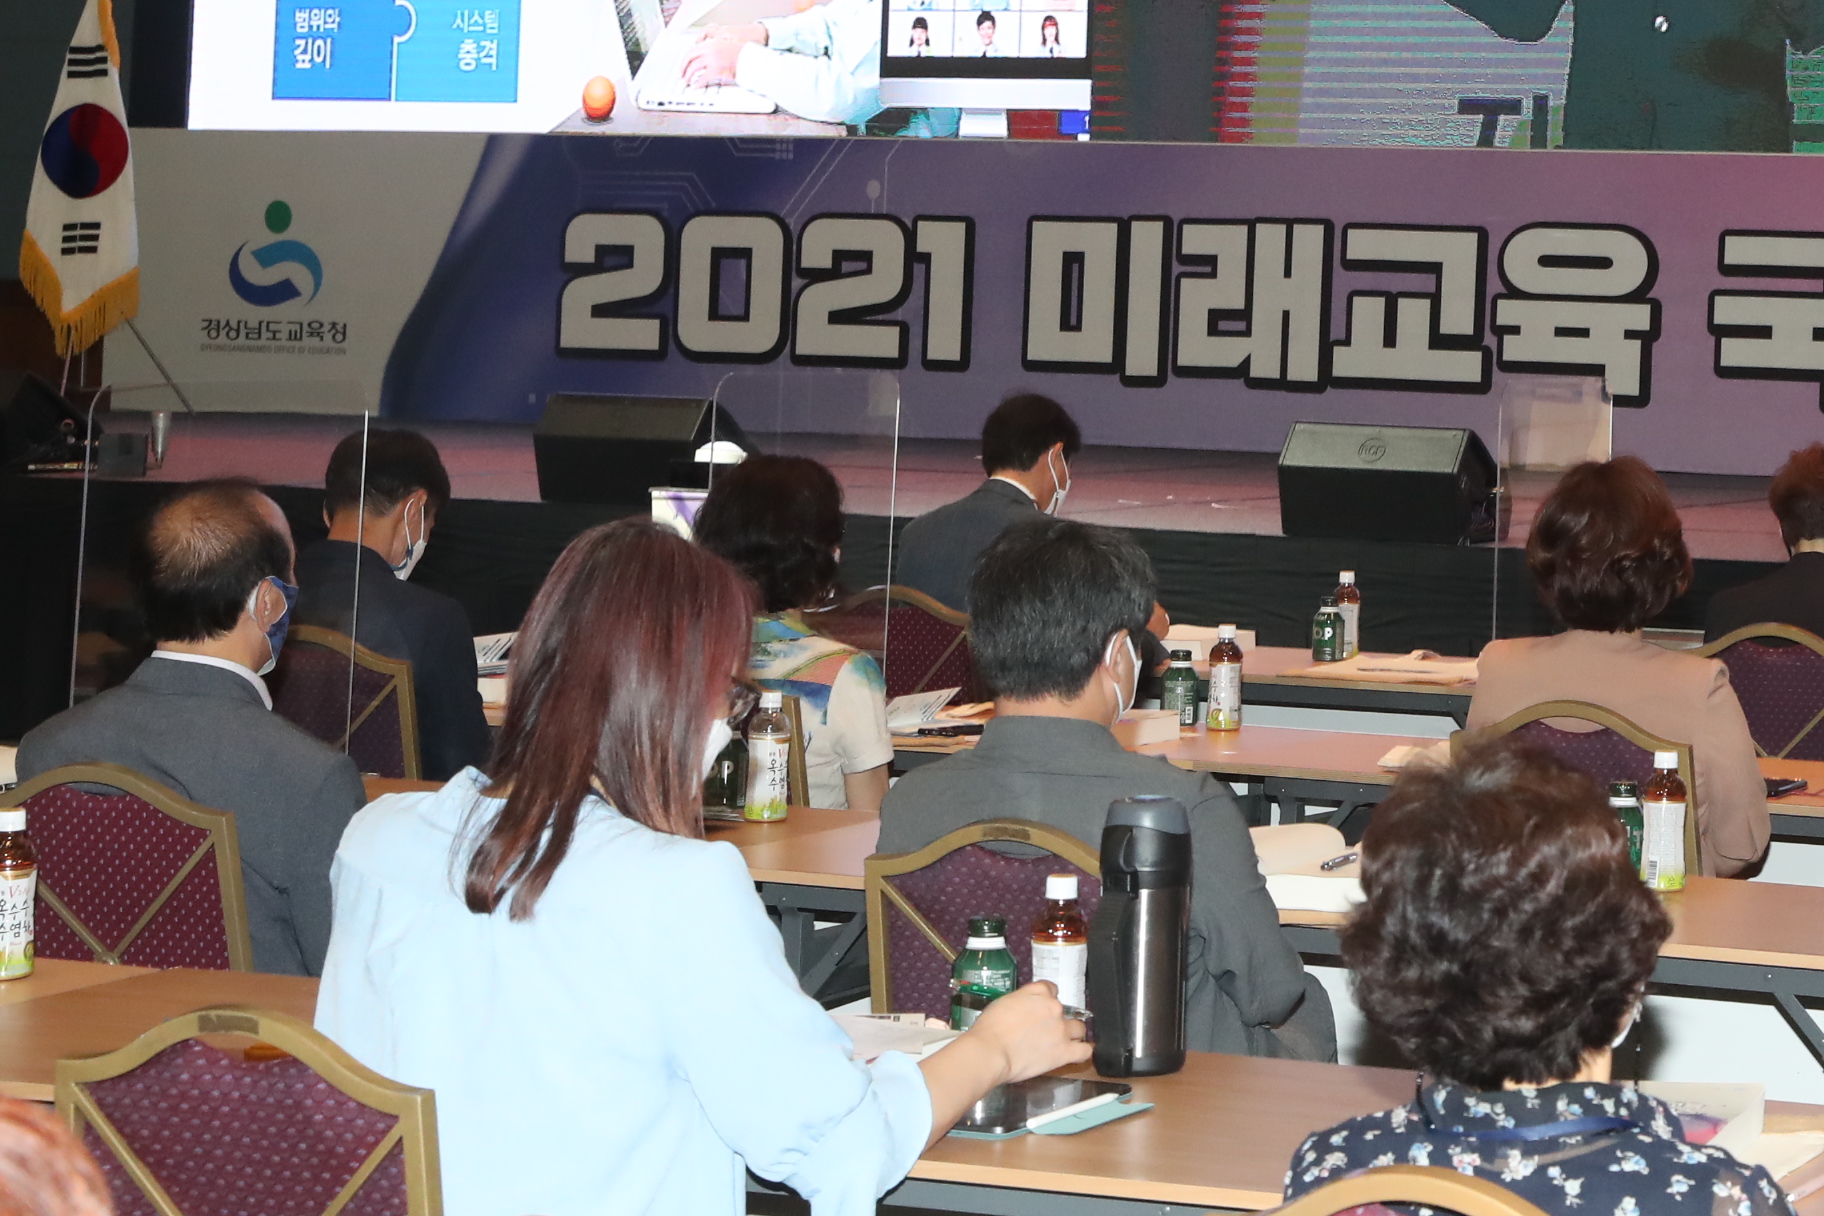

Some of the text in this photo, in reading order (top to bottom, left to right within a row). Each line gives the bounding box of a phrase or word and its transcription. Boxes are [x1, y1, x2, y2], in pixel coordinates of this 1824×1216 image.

[294, 8, 341, 33] 범위와
[451, 9, 500, 34] 시스템
[293, 36, 332, 70] 깊이
[457, 38, 499, 71] 충격
[556, 211, 975, 372] 2021
[1021, 213, 1660, 408] 미래교육
[201, 318, 348, 344] 경상남도교육청
